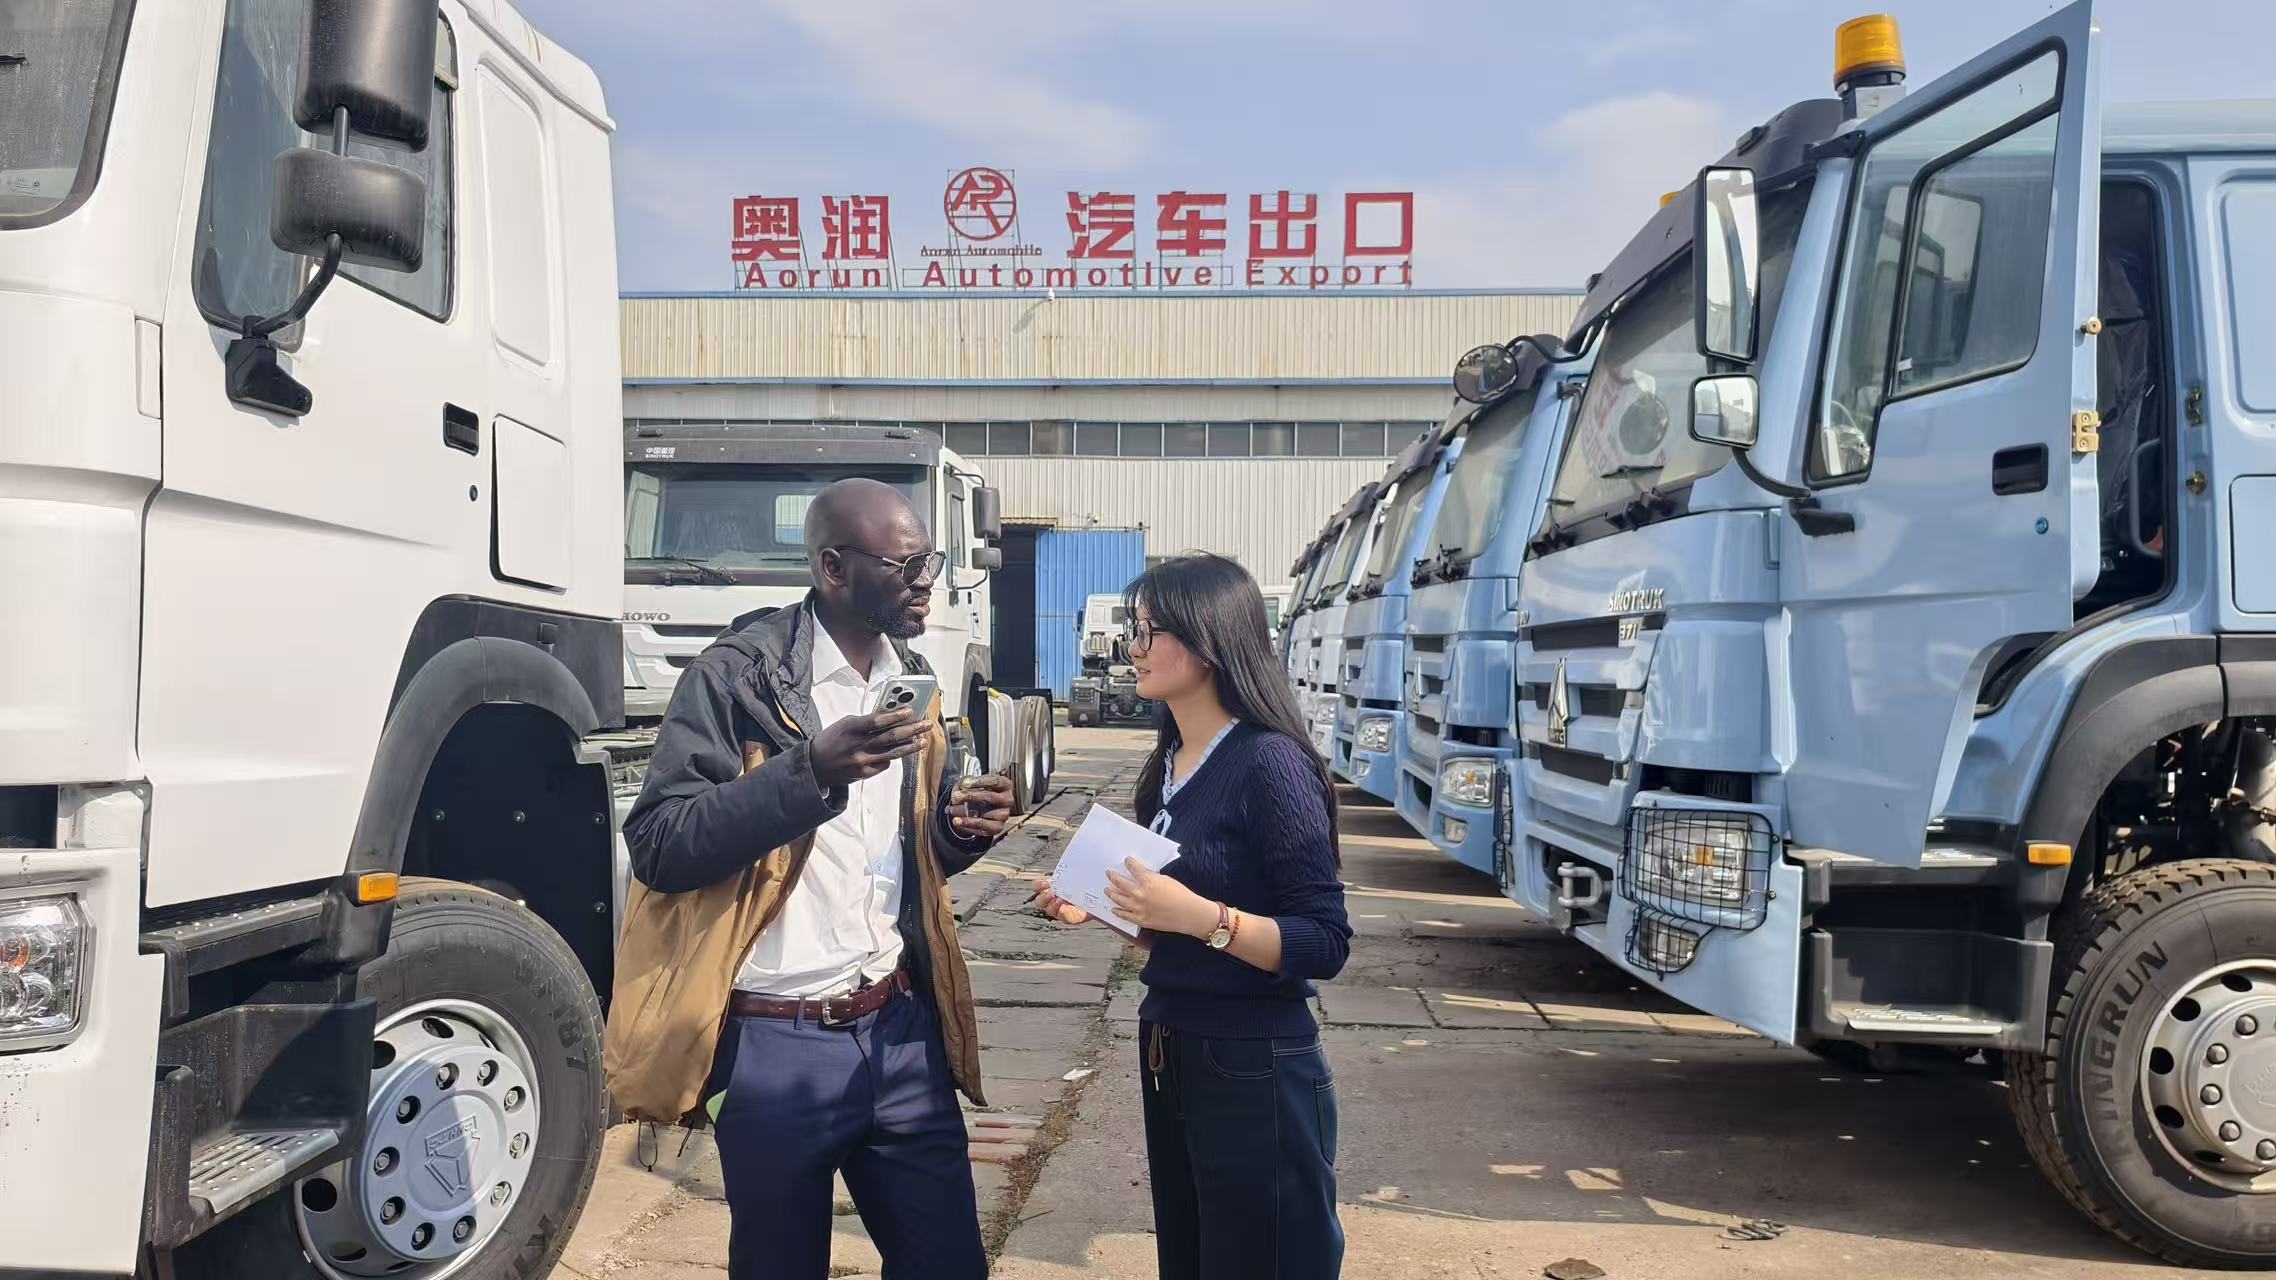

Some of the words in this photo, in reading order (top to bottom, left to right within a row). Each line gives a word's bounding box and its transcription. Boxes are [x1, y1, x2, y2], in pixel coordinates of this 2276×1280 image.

[732, 195, 889, 260] 奥润
[1066, 190, 1414, 258] 汽车出口
[744, 262, 882, 289] Aorun
[922, 260, 1213, 289] Automotive
[1246, 258, 1413, 290] Export
[1608, 588, 1664, 612] SINOTRUK
